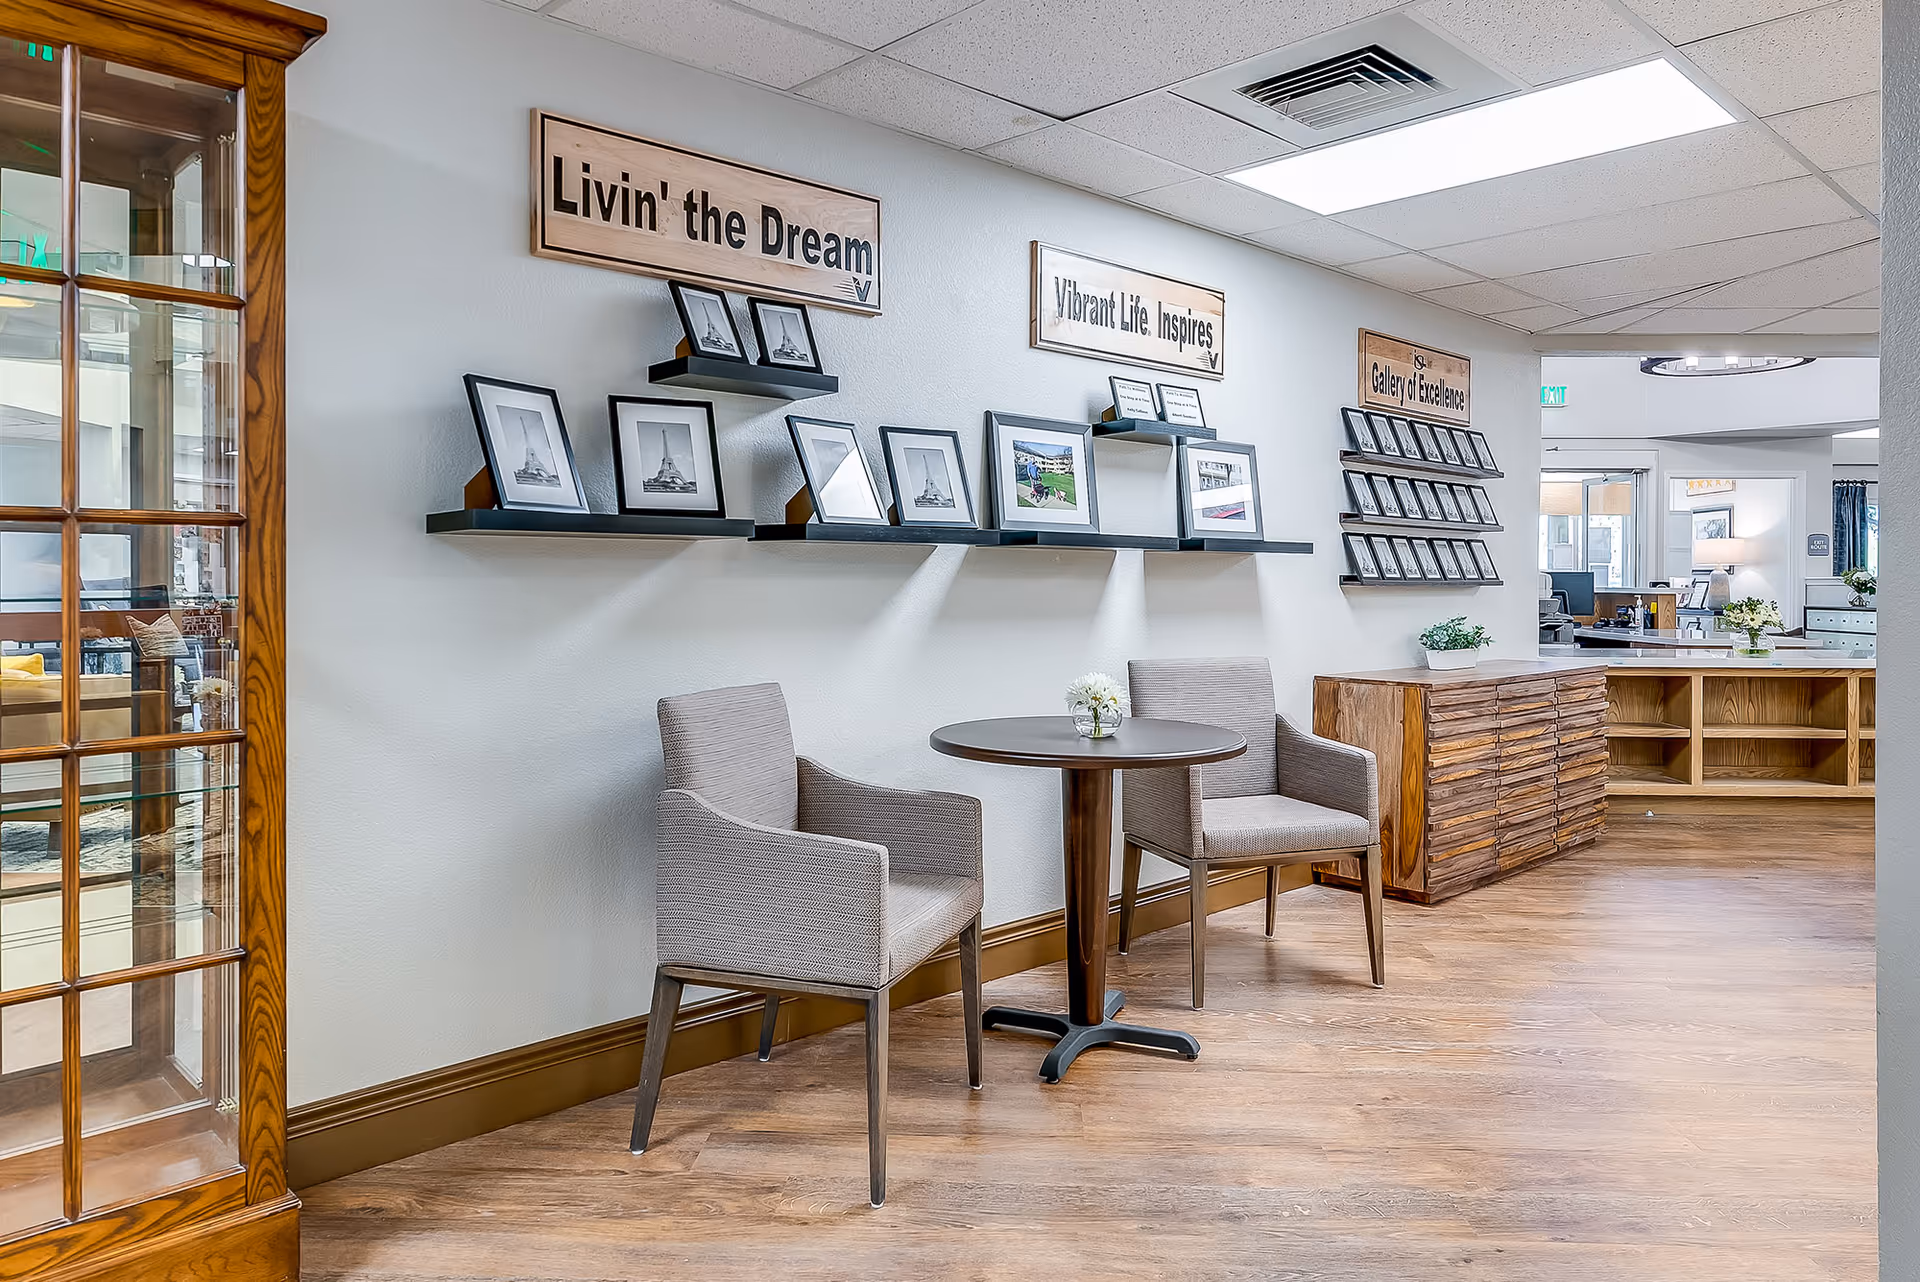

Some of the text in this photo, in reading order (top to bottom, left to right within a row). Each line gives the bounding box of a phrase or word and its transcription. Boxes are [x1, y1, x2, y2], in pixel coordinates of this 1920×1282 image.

[553, 155, 873, 276] Livin' the Dream
[1054, 276, 1116, 330] Vibrant
[1157, 301, 1213, 353] Inspires
[1371, 361, 1465, 411] Gallery of Excellence
[1541, 385, 1568, 404] EXIT
